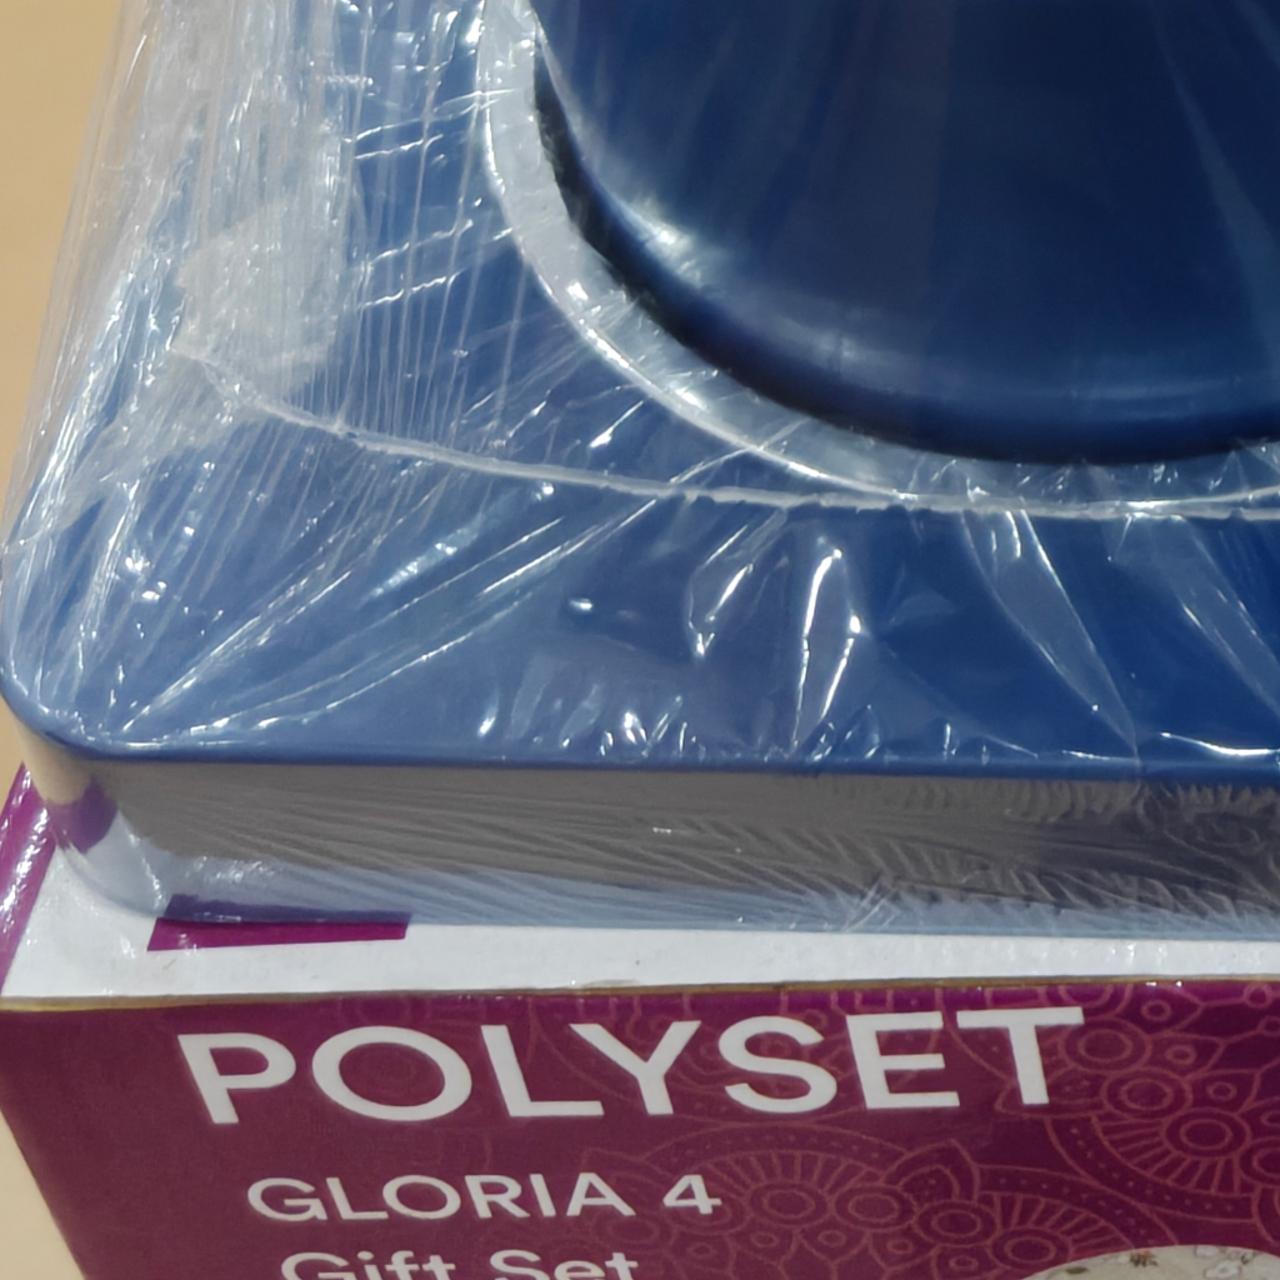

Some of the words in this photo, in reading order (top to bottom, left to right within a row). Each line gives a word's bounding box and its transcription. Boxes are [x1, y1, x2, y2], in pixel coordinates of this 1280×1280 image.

[178, 1004, 1084, 1126] POLYSET
[247, 1173, 635, 1222] GLORIA
[662, 1174, 722, 1216] 4
[280, 1248, 456, 1280] Gift
[489, 1249, 640, 1280] Set
